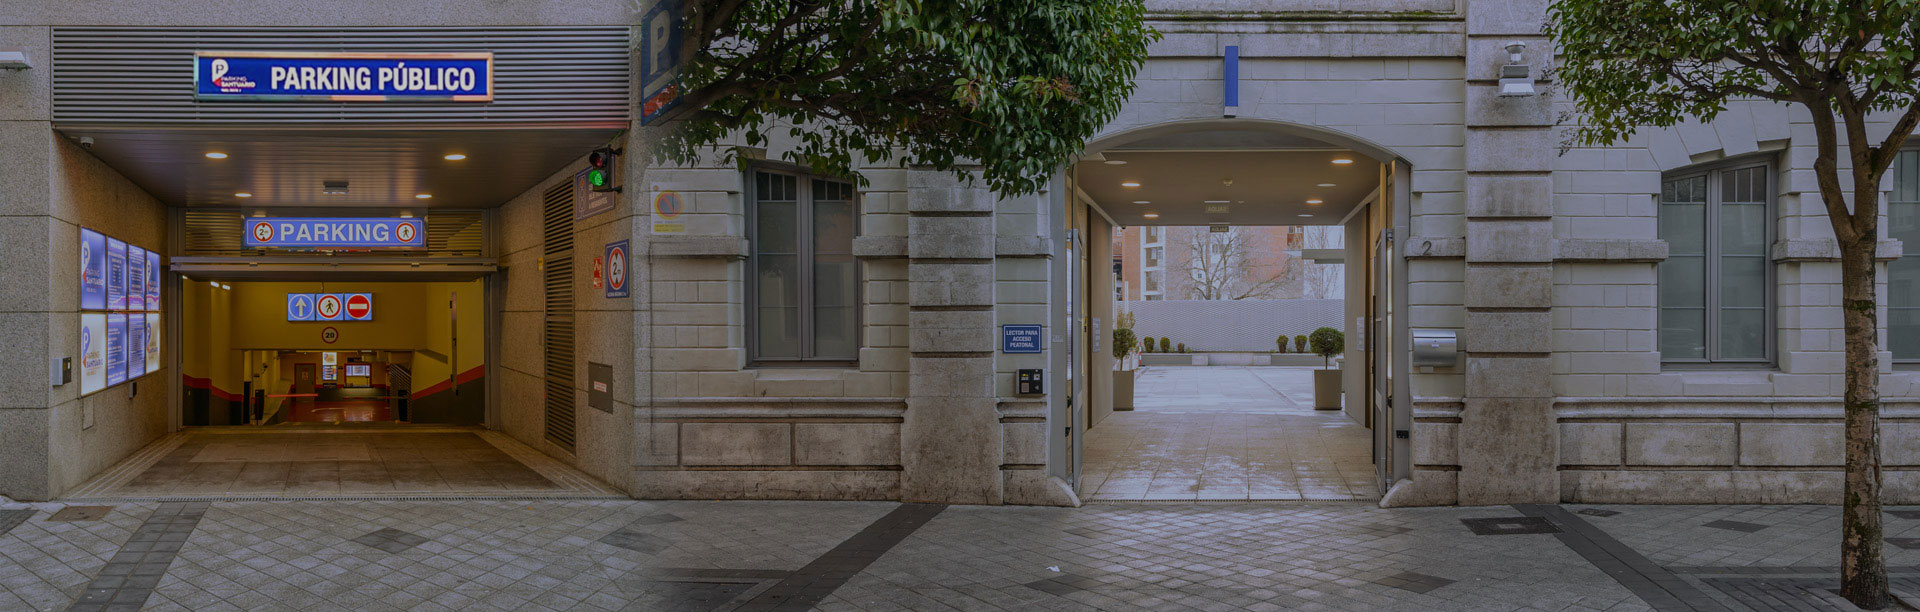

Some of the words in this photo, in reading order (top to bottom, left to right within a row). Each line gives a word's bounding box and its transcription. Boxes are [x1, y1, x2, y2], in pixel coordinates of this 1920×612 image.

[650, 10, 671, 75] P
[271, 66, 371, 90] PARKING
[378, 62, 475, 91] PÚBLICO
[280, 223, 390, 242] PARKING
[1422, 241, 1432, 255] 2
